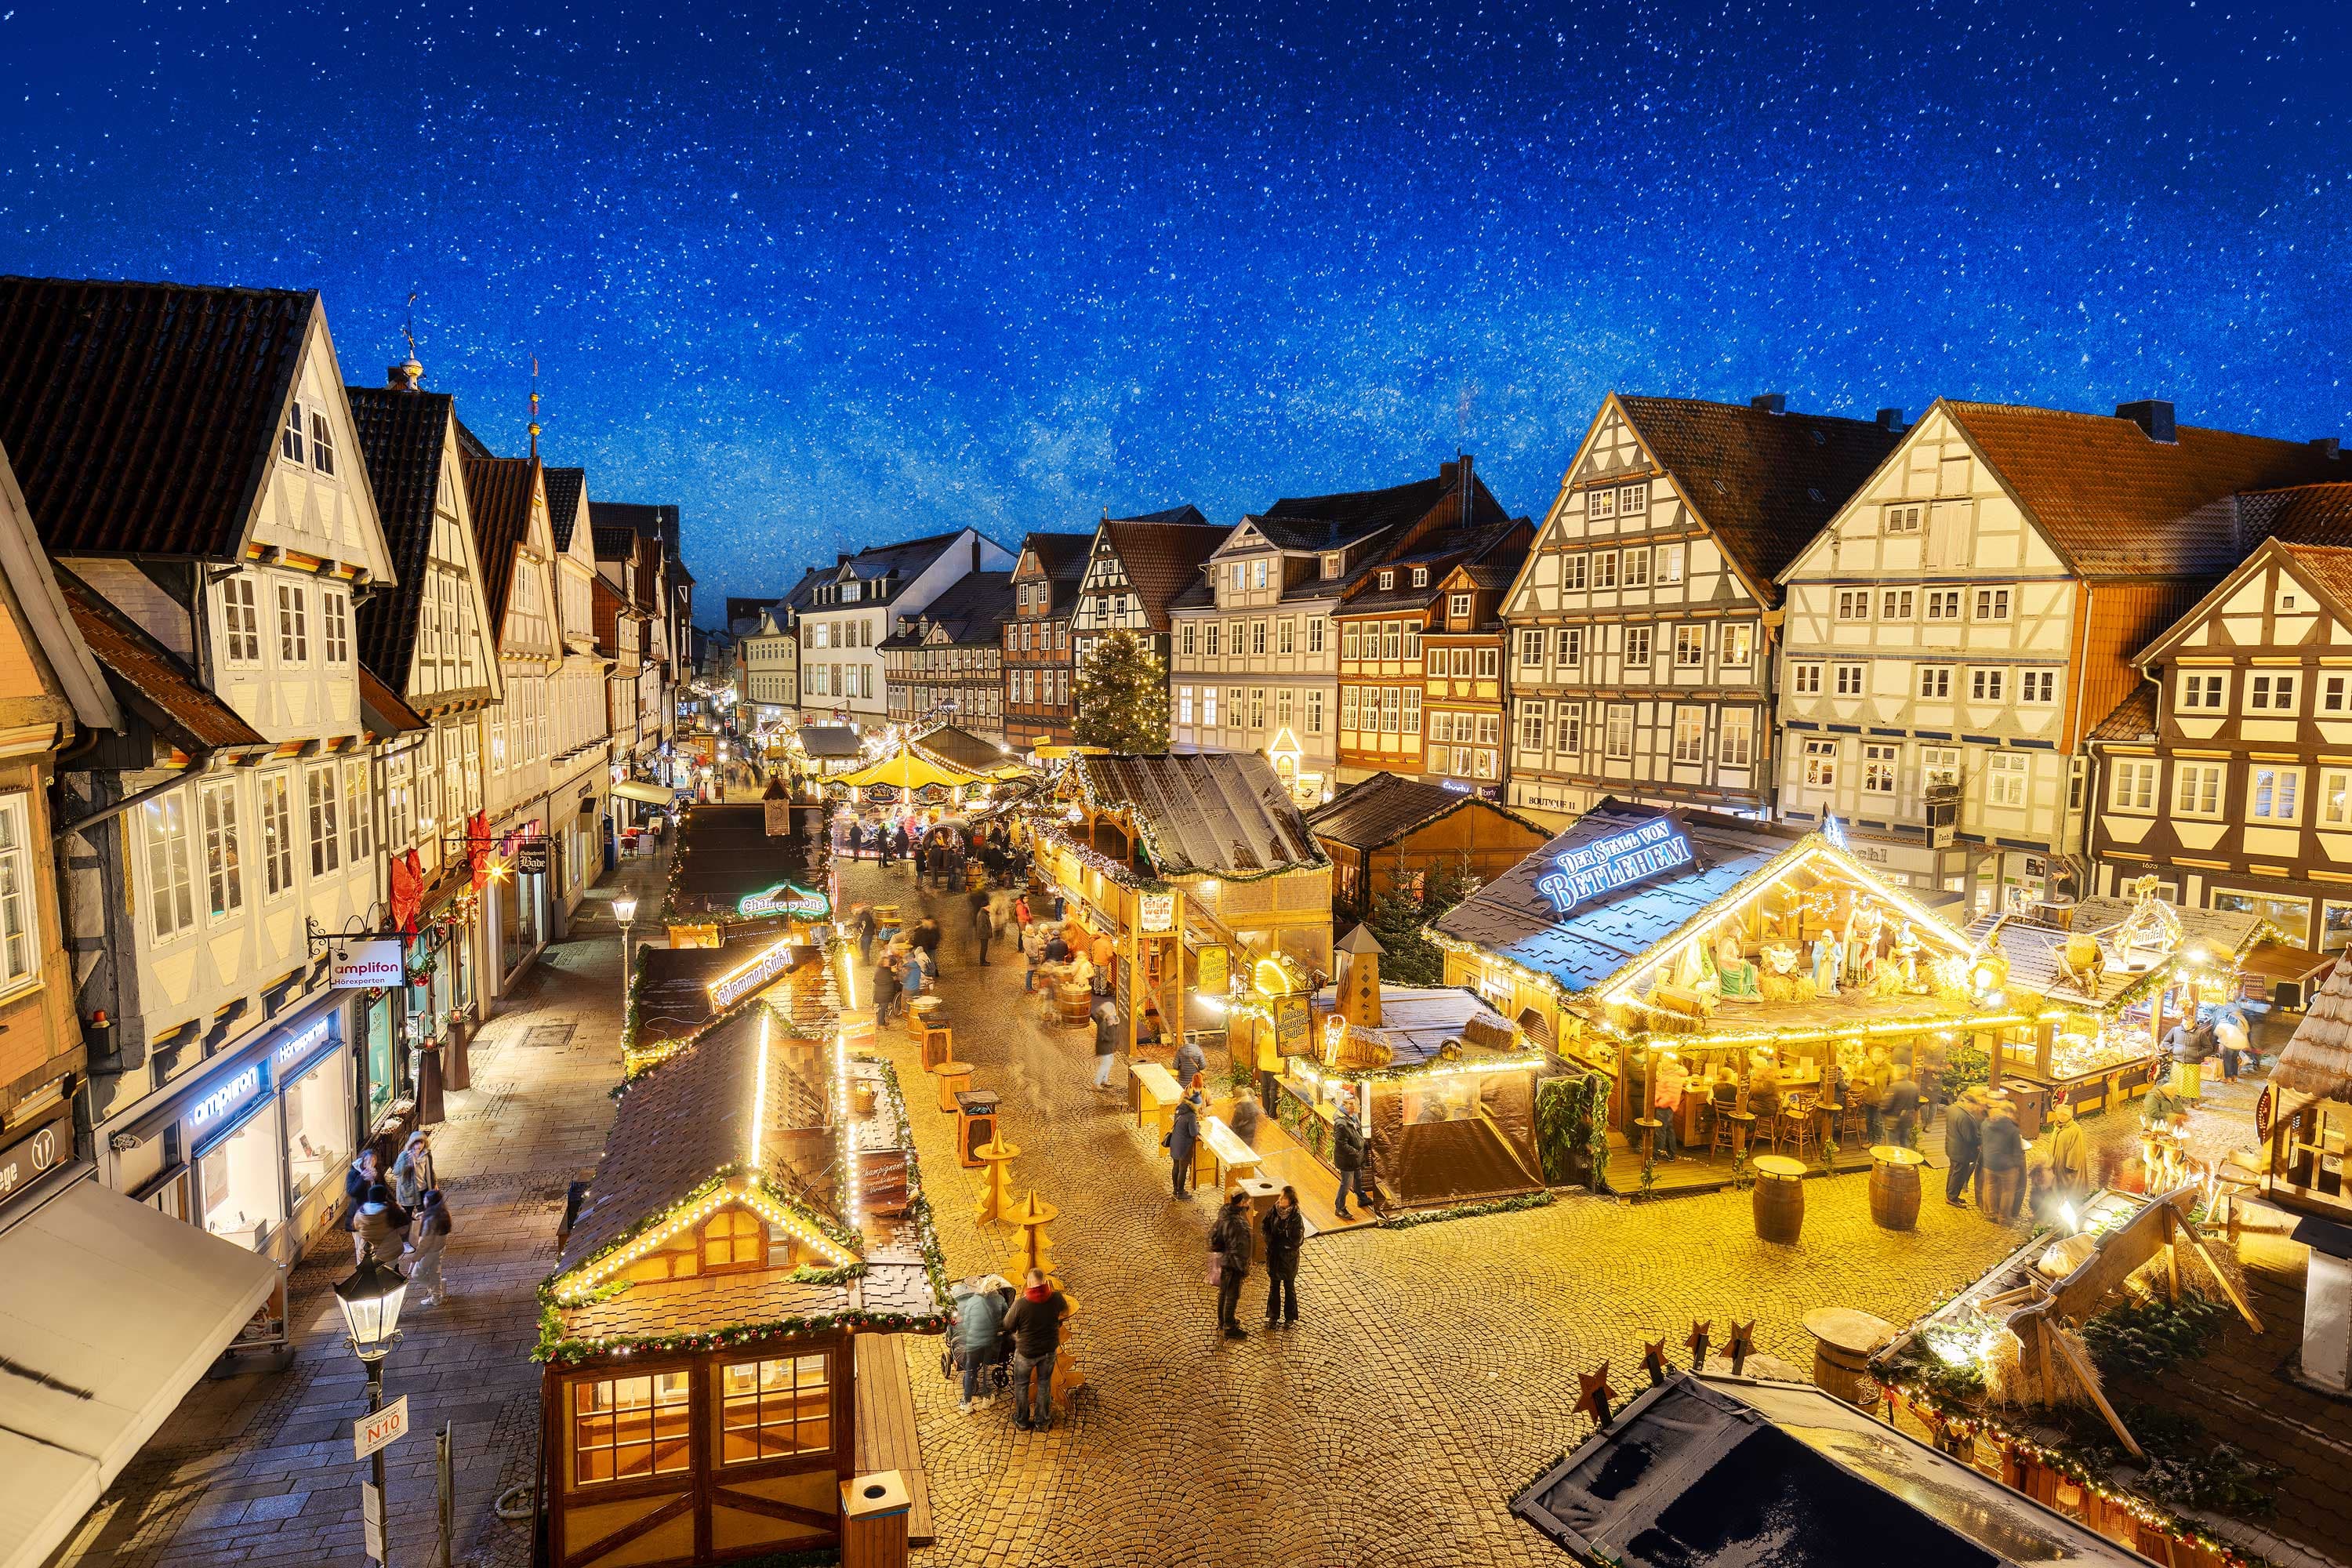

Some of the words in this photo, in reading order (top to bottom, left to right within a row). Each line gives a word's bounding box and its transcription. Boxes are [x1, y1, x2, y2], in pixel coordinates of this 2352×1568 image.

[334, 962, 398, 976] amplifon
[859, 1161, 905, 1178] Champignons
[367, 1414, 400, 1444] N10
